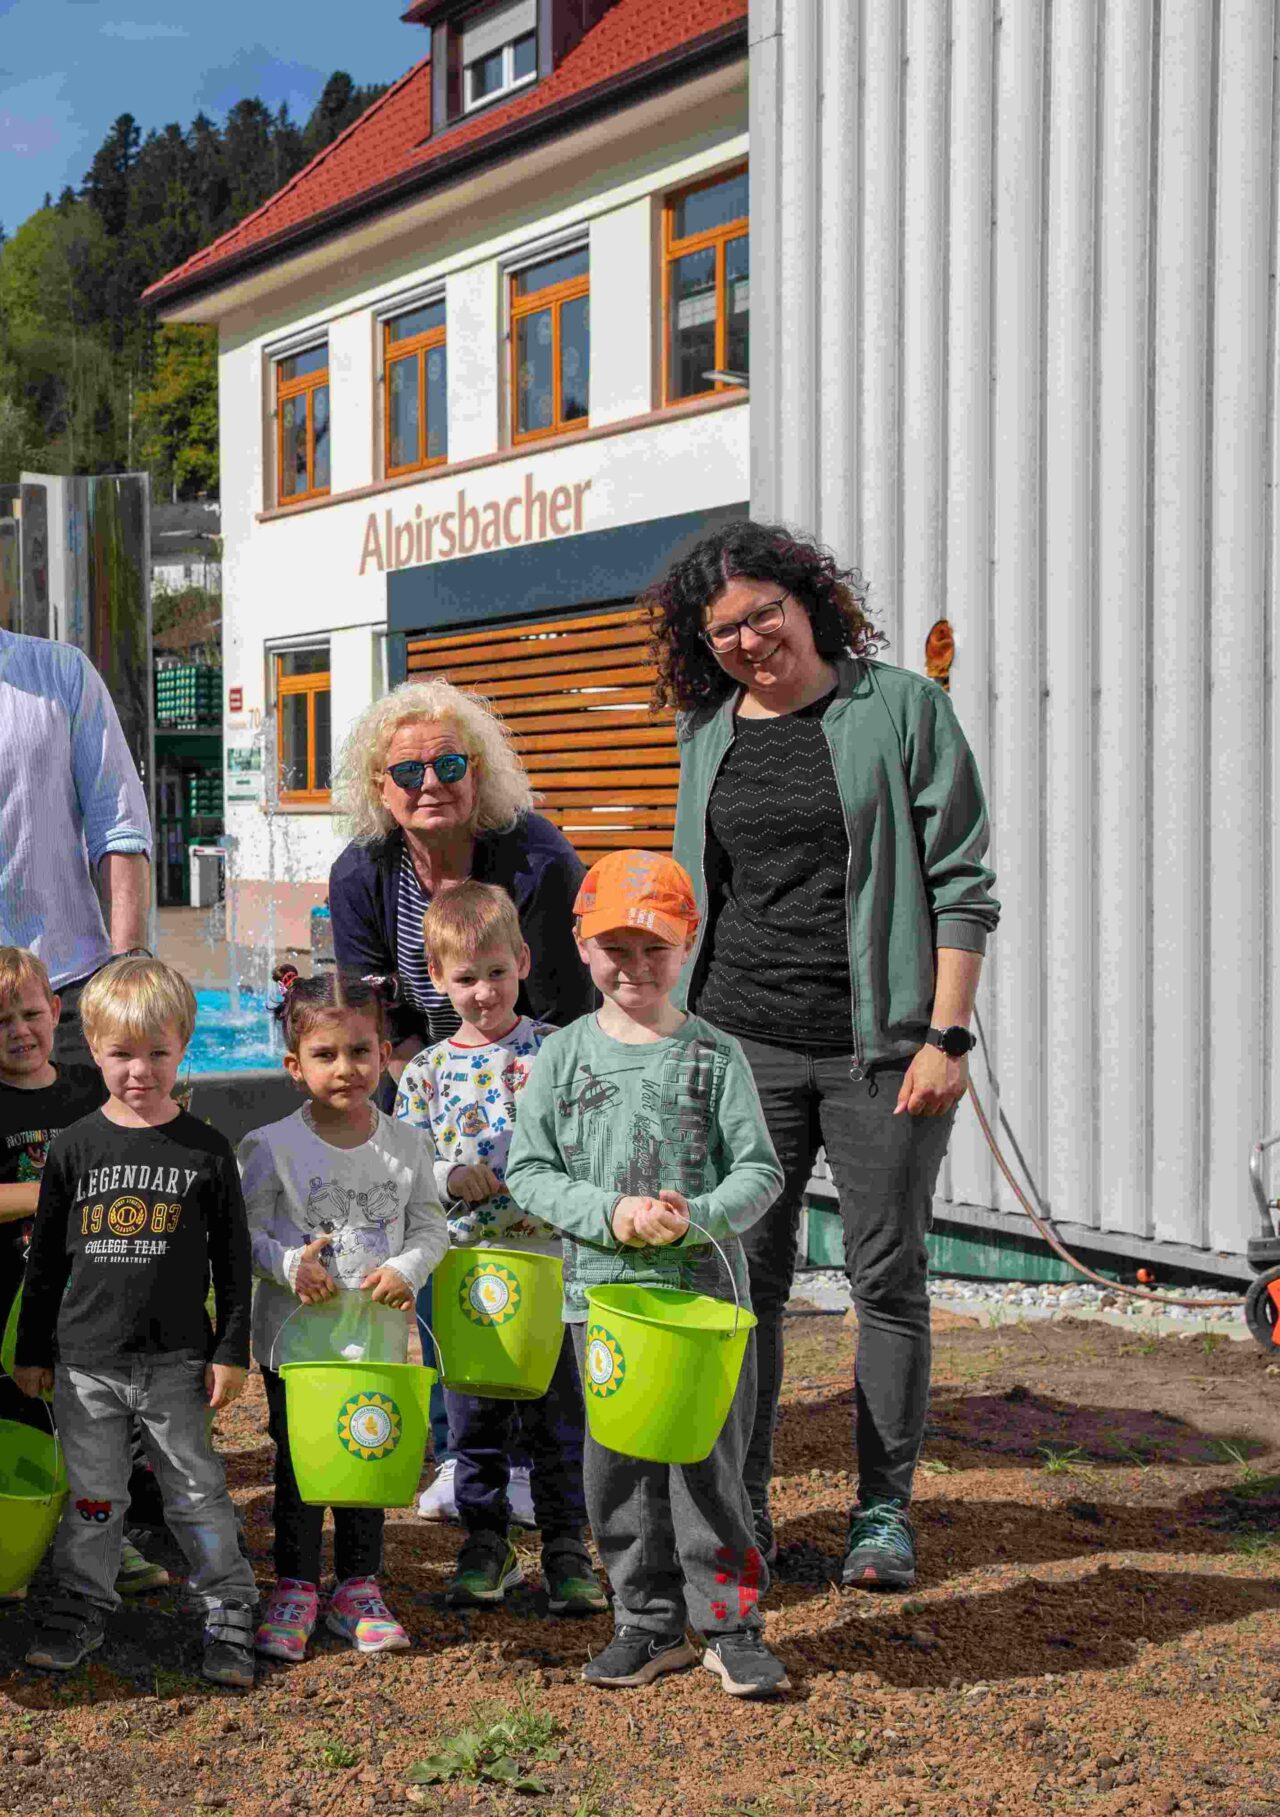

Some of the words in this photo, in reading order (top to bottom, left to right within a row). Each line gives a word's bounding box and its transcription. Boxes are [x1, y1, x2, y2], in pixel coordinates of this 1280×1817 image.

[358, 472, 592, 576] Alpirsbacher
[641, 1078, 660, 1112] Wait
[76, 1165, 198, 1202] LEGENDARY
[85, 1239, 128, 1254] COLLEGE
[134, 1240, 167, 1255] TEAM
